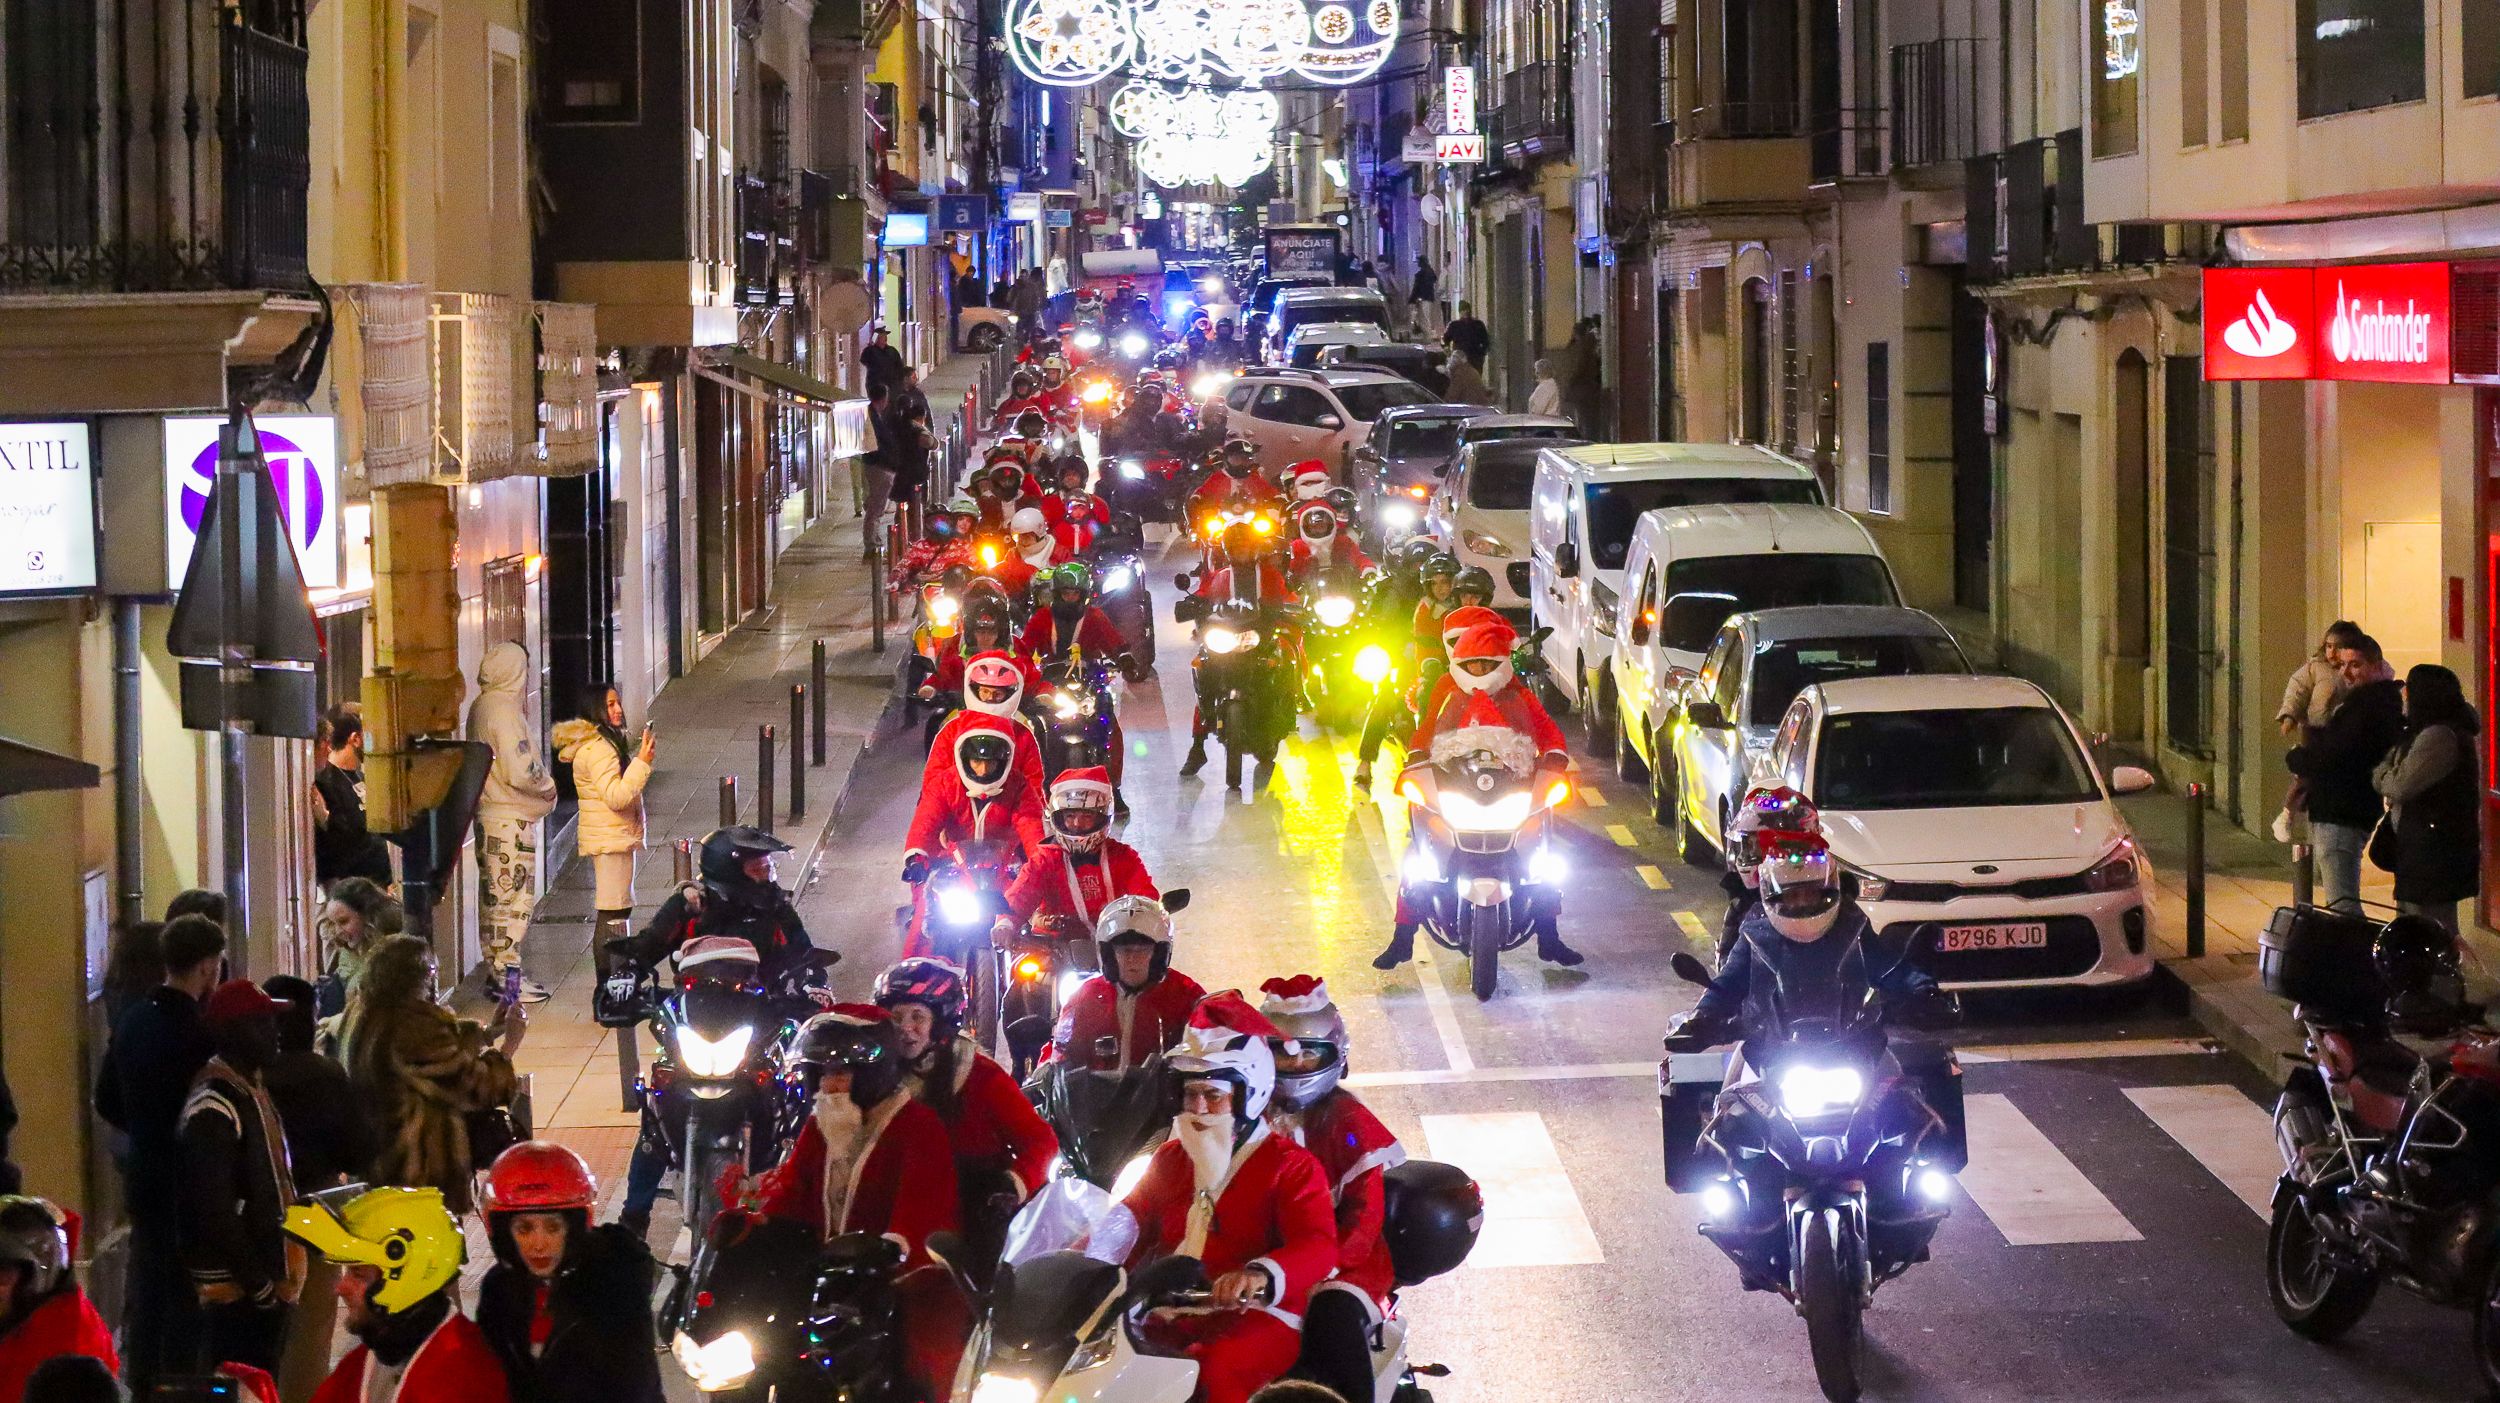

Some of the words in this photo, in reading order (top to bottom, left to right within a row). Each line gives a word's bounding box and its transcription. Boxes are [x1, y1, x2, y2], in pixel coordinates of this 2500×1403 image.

[1452, 69, 1468, 133] CARNICERIA
[1438, 142, 1483, 158] JAVI
[2351, 298, 2431, 363] Santander
[1948, 928, 1997, 948] 8796
[2005, 926, 2042, 945] KJD
